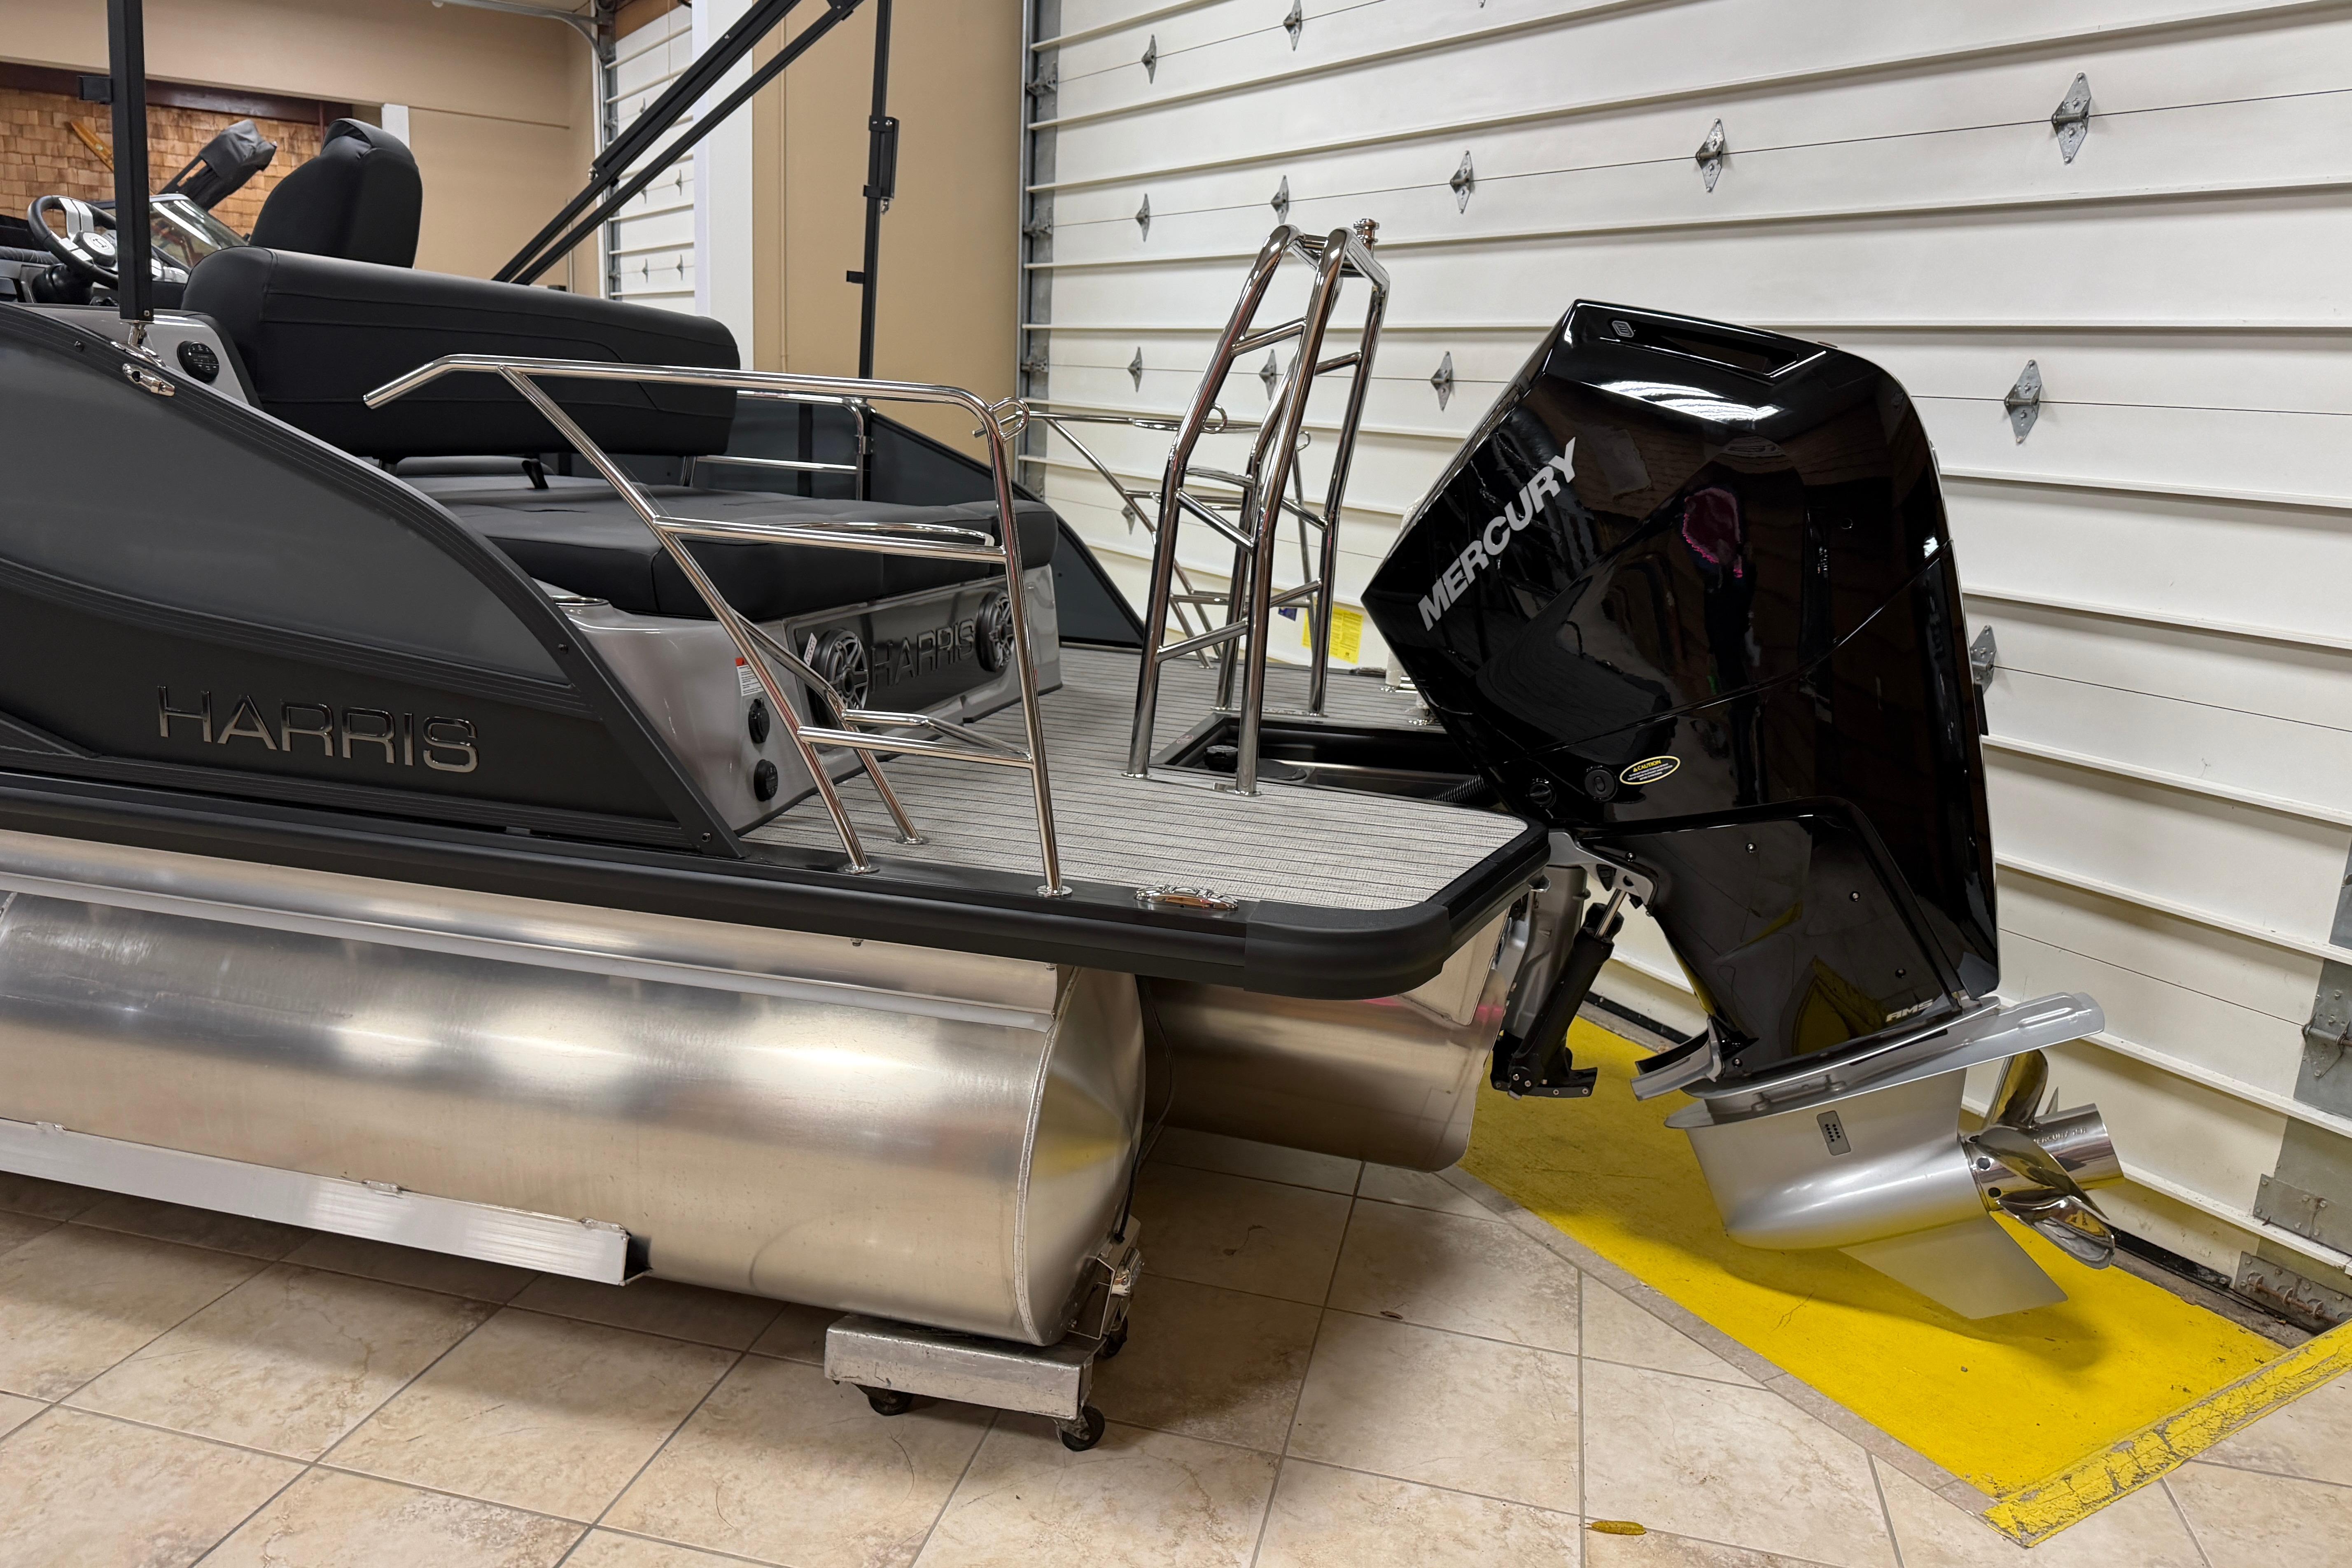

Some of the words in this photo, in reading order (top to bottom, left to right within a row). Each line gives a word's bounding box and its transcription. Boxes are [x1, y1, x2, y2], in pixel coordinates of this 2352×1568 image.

[1418, 437, 1576, 632] MERCURY
[871, 618, 975, 693] HARRIS
[156, 685, 479, 774] HARRIS
[1637, 760, 1661, 770] CAUTION
[1885, 999, 1933, 1022] AMS
